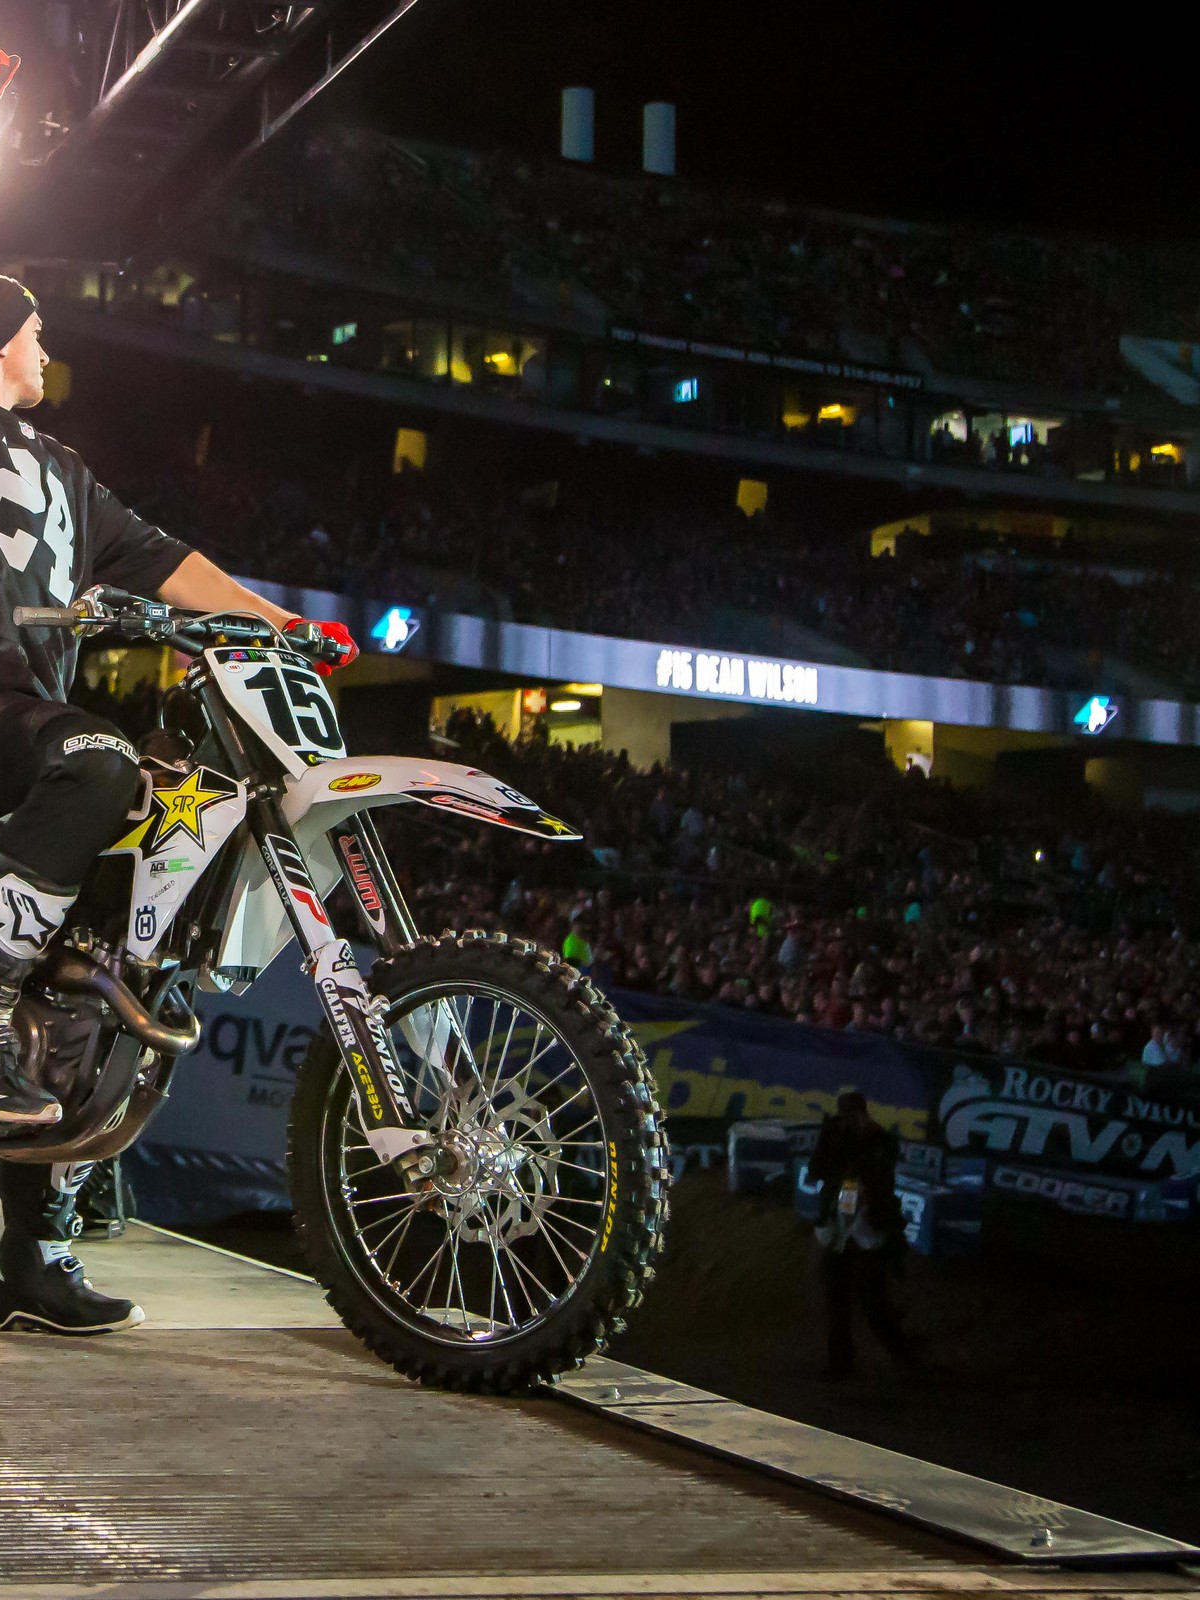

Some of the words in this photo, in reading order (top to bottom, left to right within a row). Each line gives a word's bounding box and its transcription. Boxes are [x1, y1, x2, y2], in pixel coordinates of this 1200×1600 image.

[243, 666, 343, 751] 15
[696, 653, 745, 696] DEAN
[747, 660, 818, 705] WILSON
[330, 773, 382, 792] FMF
[321, 981, 357, 1049] GALFER
[945, 1101, 1130, 1166] ATV
